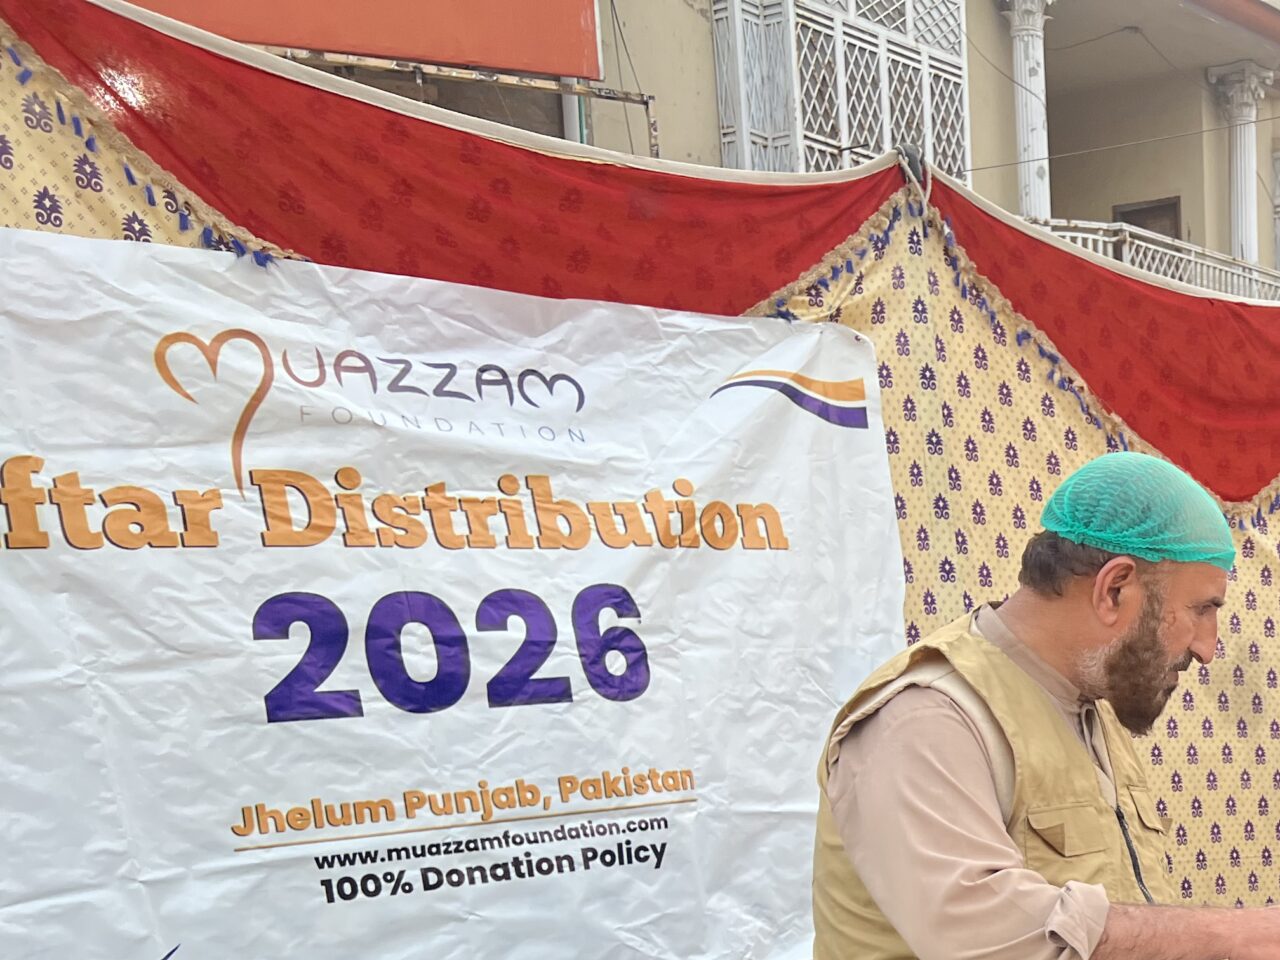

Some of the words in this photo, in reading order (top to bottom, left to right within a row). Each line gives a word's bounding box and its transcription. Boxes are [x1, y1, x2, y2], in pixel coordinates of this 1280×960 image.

[153, 327, 586, 501] MUAZZAM
[299, 403, 587, 443] FOUNDATION
[0, 455, 224, 550] ftar
[250, 466, 789, 551] Distribution
[252, 583, 651, 724] 2026
[230, 796, 395, 837] Jhelum
[403, 779, 552, 823] Punjab,
[558, 766, 696, 803] Pakistan
[314, 814, 669, 870] www.muazzamfoundation.com
[320, 868, 415, 903] 100%
[420, 847, 576, 892] Donation
[582, 840, 667, 870] Policy
